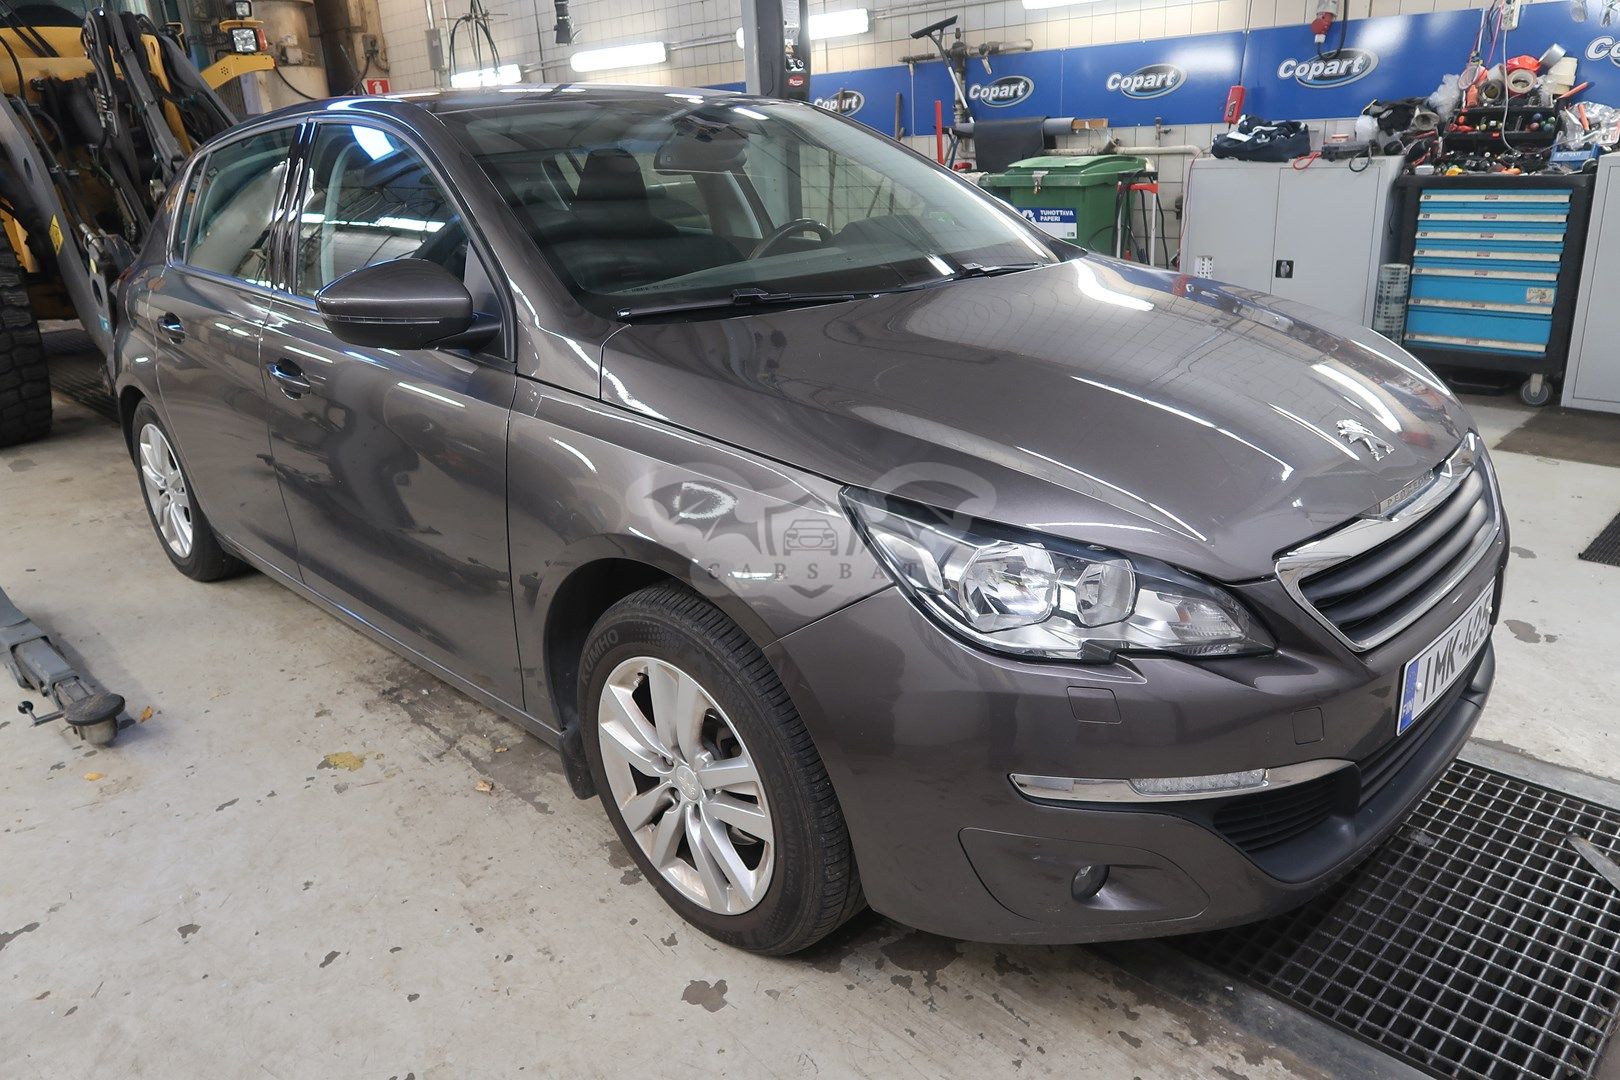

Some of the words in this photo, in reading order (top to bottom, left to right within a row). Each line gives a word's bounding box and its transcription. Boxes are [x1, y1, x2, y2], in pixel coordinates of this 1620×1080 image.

[1278, 55, 1364, 80] Copart
[968, 81, 1025, 101] Copart
[1106, 69, 1176, 92] Copart
[582, 629, 619, 688] KUMHO
